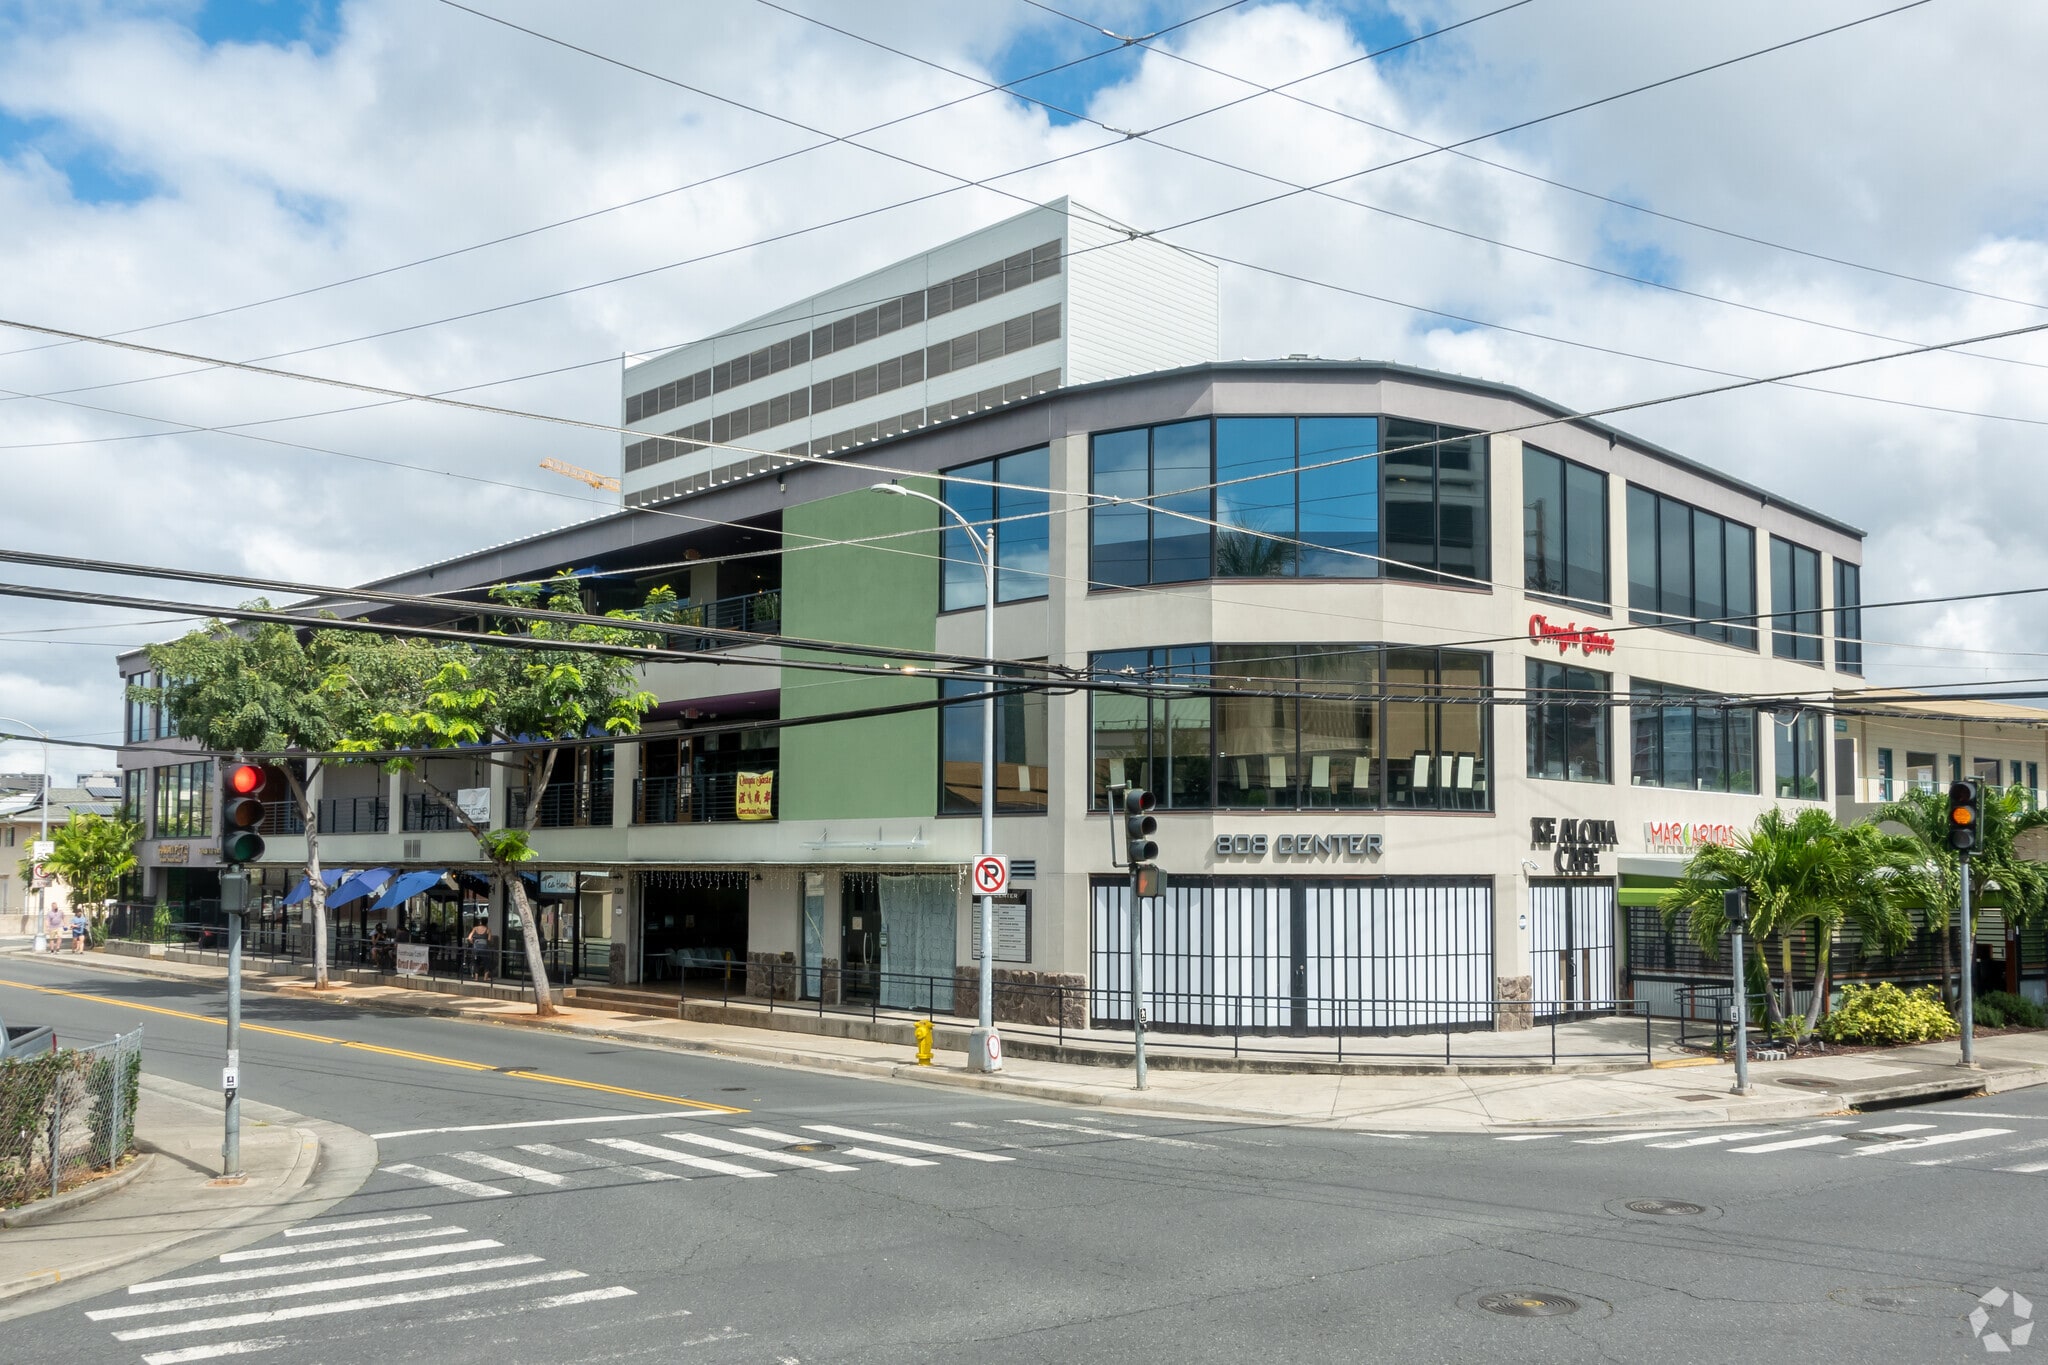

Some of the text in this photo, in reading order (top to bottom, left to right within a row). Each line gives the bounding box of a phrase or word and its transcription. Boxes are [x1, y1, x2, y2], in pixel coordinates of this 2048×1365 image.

[1530, 817, 1619, 844] KE ALOHA
[1216, 834, 1383, 854] 808 CENTER
[1554, 846, 1600, 872] CAFE
